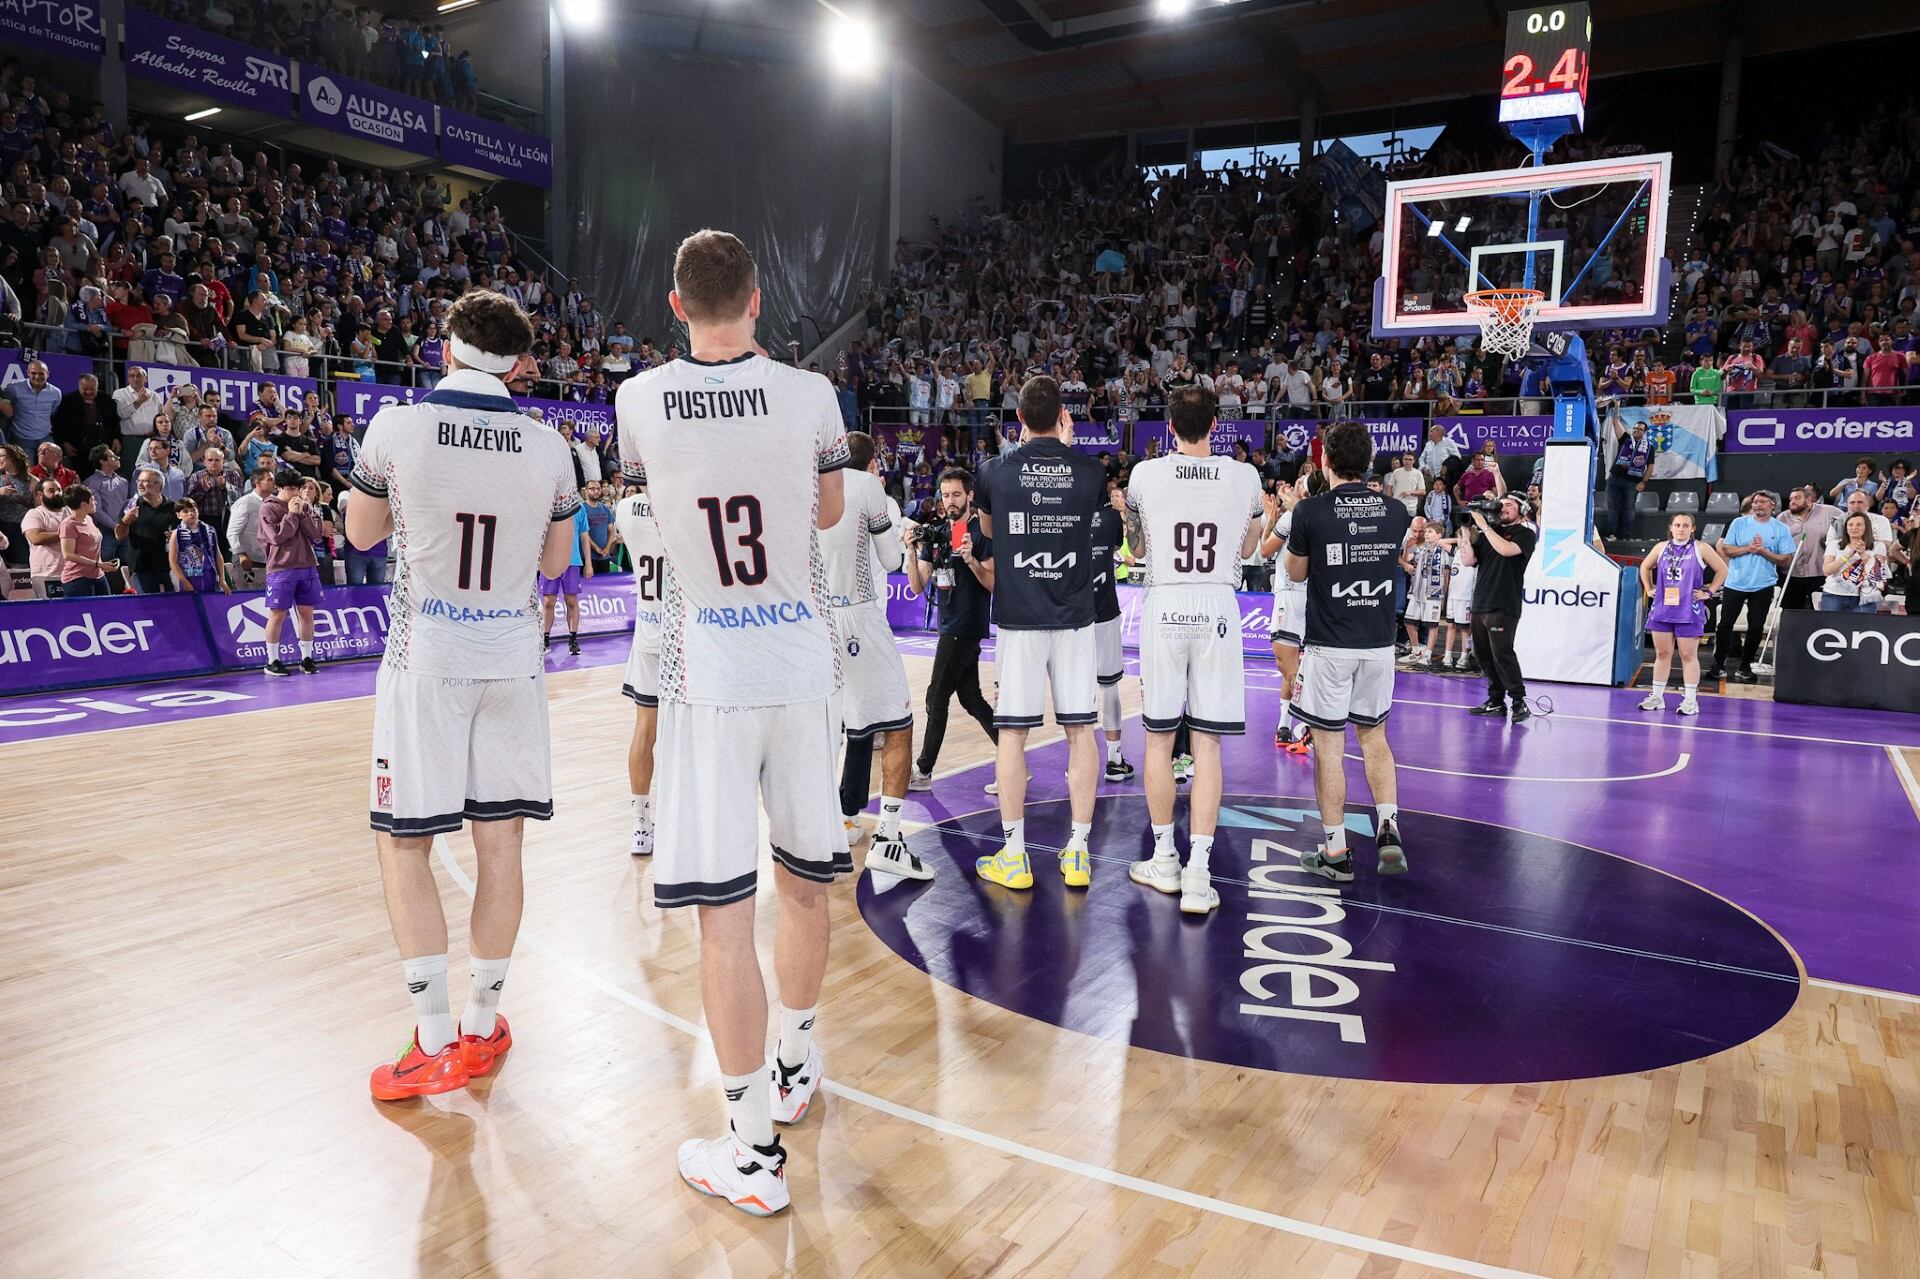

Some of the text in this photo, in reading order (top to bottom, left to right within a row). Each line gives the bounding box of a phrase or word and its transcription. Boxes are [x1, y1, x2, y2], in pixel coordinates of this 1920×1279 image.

[1527, 10, 1566, 34] 0.0
[29, 25, 42, 36] de
[44, 28, 101, 53] Transporte
[166, 35, 226, 65] Seguros
[132, 50, 258, 97] Albadri Revilla
[245, 56, 289, 91] SAR
[1501, 48, 1580, 96] 2.4
[346, 94, 428, 133] AUPASA
[352, 117, 401, 139] OCASIÓN
[446, 124, 548, 165] CASTILLA Y LEÓN
[488, 153, 523, 169] IMPULSA
[547, 406, 607, 426] SABORES
[663, 388, 769, 421] PUSTOVYI
[1565, 403, 1574, 433] MONDO
[1796, 416, 1914, 440] cofersa
[1021, 463, 1072, 474] A Coruña
[1335, 495, 1383, 504] A Coruña
[455, 511, 497, 592] 11
[697, 494, 770, 588] 13
[1173, 521, 1219, 574] 93
[1029, 569, 1063, 580] Santiago
[1160, 612, 1210, 623] A Coruña
[1346, 598, 1380, 608] Santiago
[1239, 838, 1397, 1044] zunder
